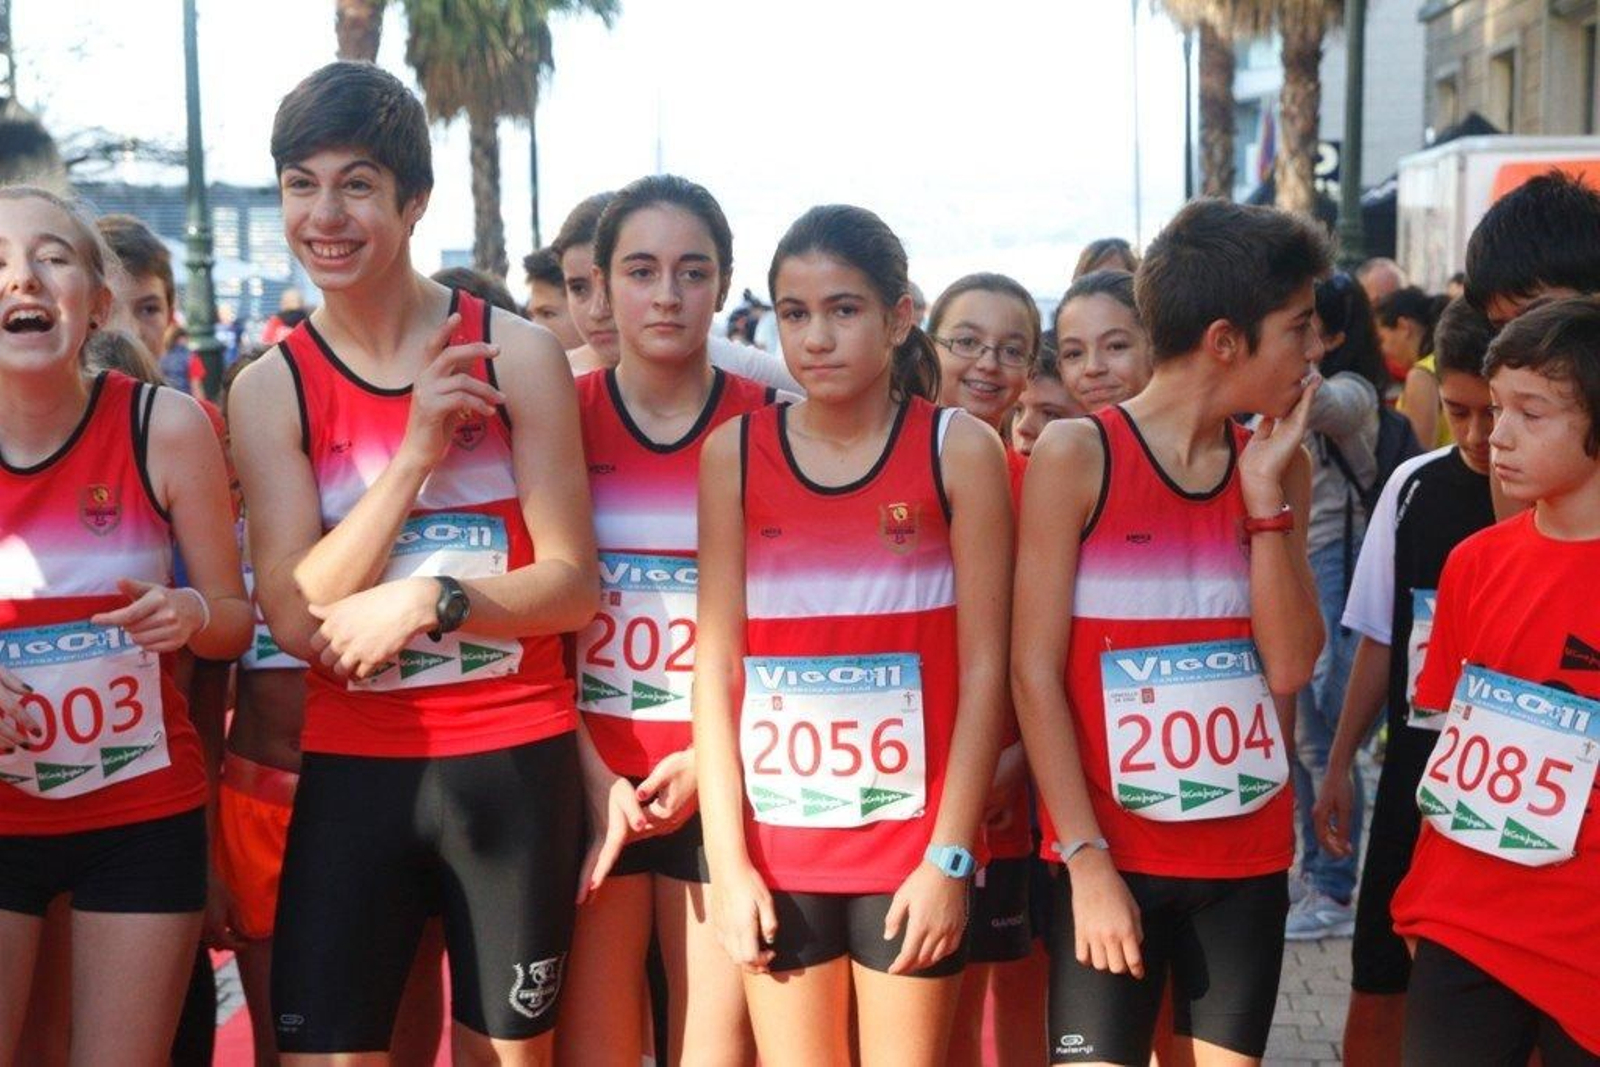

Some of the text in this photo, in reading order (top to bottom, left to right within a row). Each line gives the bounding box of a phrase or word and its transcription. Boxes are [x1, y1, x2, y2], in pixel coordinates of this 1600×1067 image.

[0, 675, 143, 752] 003
[752, 718, 908, 777] 2056
[1118, 703, 1275, 773] 2004
[1429, 726, 1574, 817] 2085
